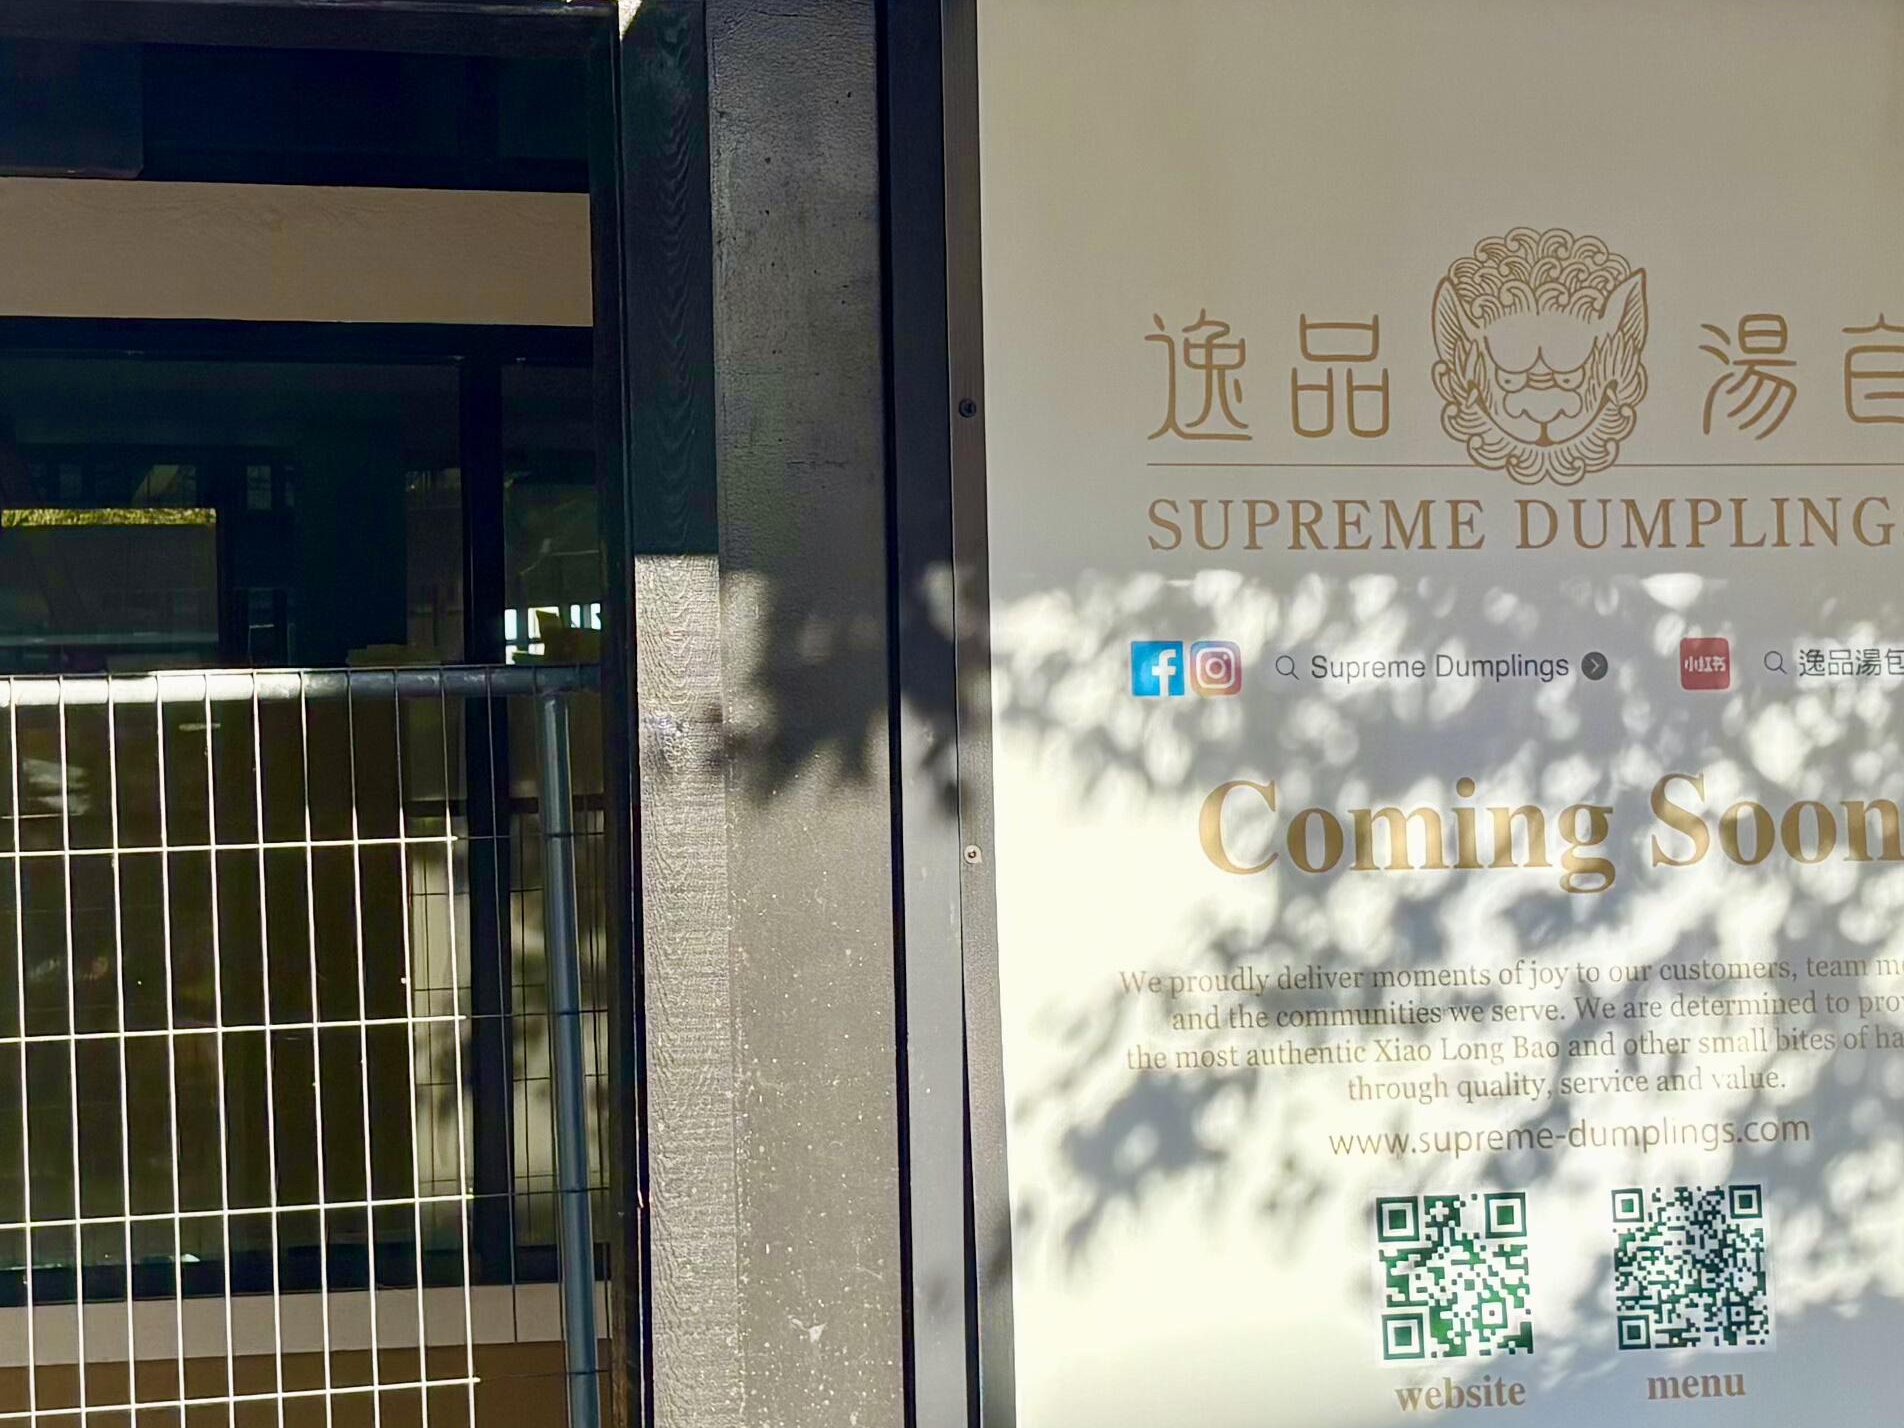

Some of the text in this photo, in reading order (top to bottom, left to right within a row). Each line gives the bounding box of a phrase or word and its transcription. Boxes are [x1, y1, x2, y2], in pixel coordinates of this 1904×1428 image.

[1144, 307, 1391, 443] 逸品
[1146, 497, 1486, 552] SUPREME
[1311, 653, 1568, 684] Supreme Dumplings
[1198, 776, 1616, 894] Coming
[1120, 970, 1161, 994] We
[1170, 966, 1269, 999] proudly
[1278, 965, 1364, 990] deliver
[1372, 964, 1490, 987] moments
[1499, 961, 1523, 985] of
[1528, 962, 1568, 990] joy
[1576, 963, 1600, 983] to
[1609, 967, 1652, 982] our
[1660, 958, 1797, 983] customers,
[1807, 956, 1868, 977] team
[1172, 1005, 1220, 1030] and
[1230, 1003, 1268, 1028] the
[1276, 1000, 1442, 1027] communities
[1448, 1005, 1484, 1022] we
[1492, 1002, 1565, 1022] serve.
[1575, 996, 1616, 1021] We
[1623, 1001, 1662, 1019] are
[1670, 990, 1816, 1016] determined
[1826, 993, 1849, 1013] to
[1126, 1045, 1166, 1070] the
[1176, 1045, 1237, 1068] most
[1247, 1039, 1366, 1066] authentic
[1373, 1039, 1431, 1062] Xiao
[1440, 1038, 1504, 1064] Long
[1513, 1035, 1559, 1059] Bao
[1569, 1032, 1614, 1057] and
[1624, 1030, 1691, 1055] other
[1698, 1028, 1767, 1054] small
[1776, 1027, 1835, 1051] bites
[1844, 1026, 1868, 1049] of
[1349, 1066, 1785, 1104] through quality, service and value.
[1329, 1117, 1810, 1159] www.supreme-dumplings.com
[1395, 1374, 1526, 1411] website
[1646, 1372, 1746, 1401] menu
